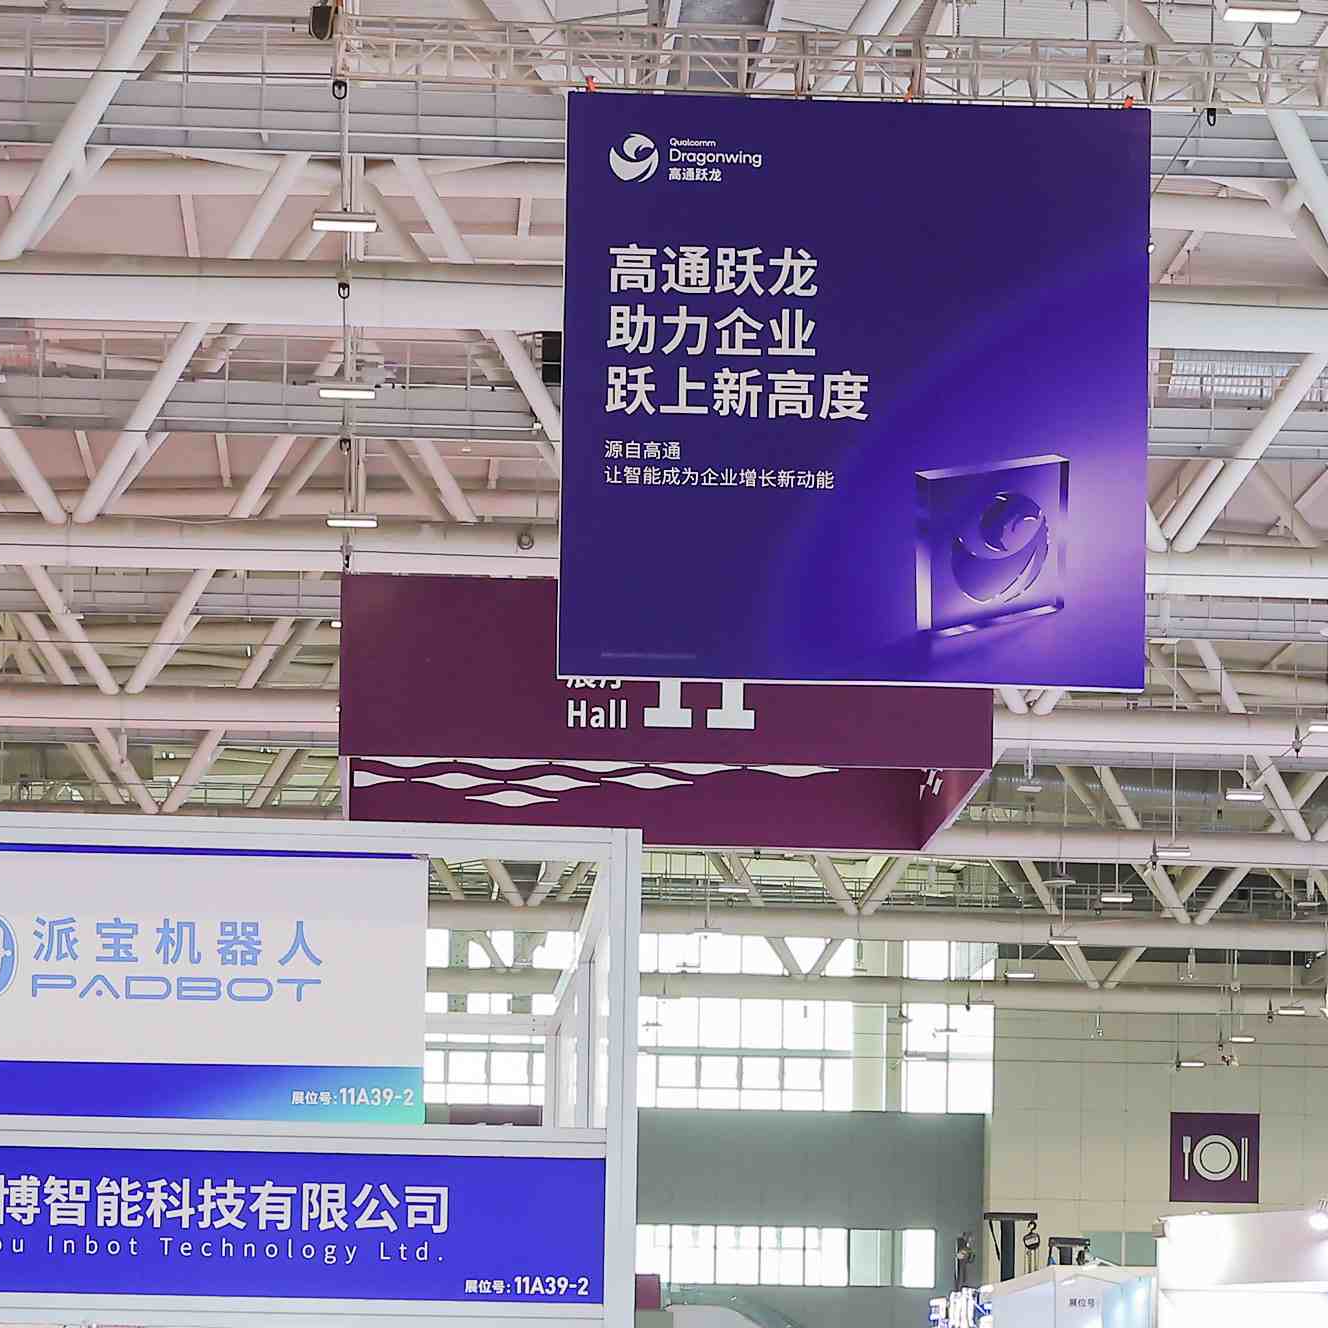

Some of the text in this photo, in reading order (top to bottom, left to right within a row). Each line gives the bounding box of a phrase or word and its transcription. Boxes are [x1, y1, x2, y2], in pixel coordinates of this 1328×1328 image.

[669, 137, 716, 147] Qualcomm
[668, 148, 762, 167] Dragonwing
[668, 167, 722, 182] 高通跃龙
[607, 243, 819, 297] 高通跃龙
[606, 304, 817, 358] 助力企业
[604, 366, 870, 421] 跃上新高度
[604, 440, 682, 460] 源自高通
[604, 465, 835, 490] 让智能成为企业增长新动能
[567, 699, 627, 729] Hall
[32, 916, 323, 967] 派宝机器人
[32, 975, 323, 1003] PADBOT
[48, 1234, 140, 1257] Inbot
[160, 1236, 359, 1264] Technology
[379, 1240, 444, 1262] Ltd.
